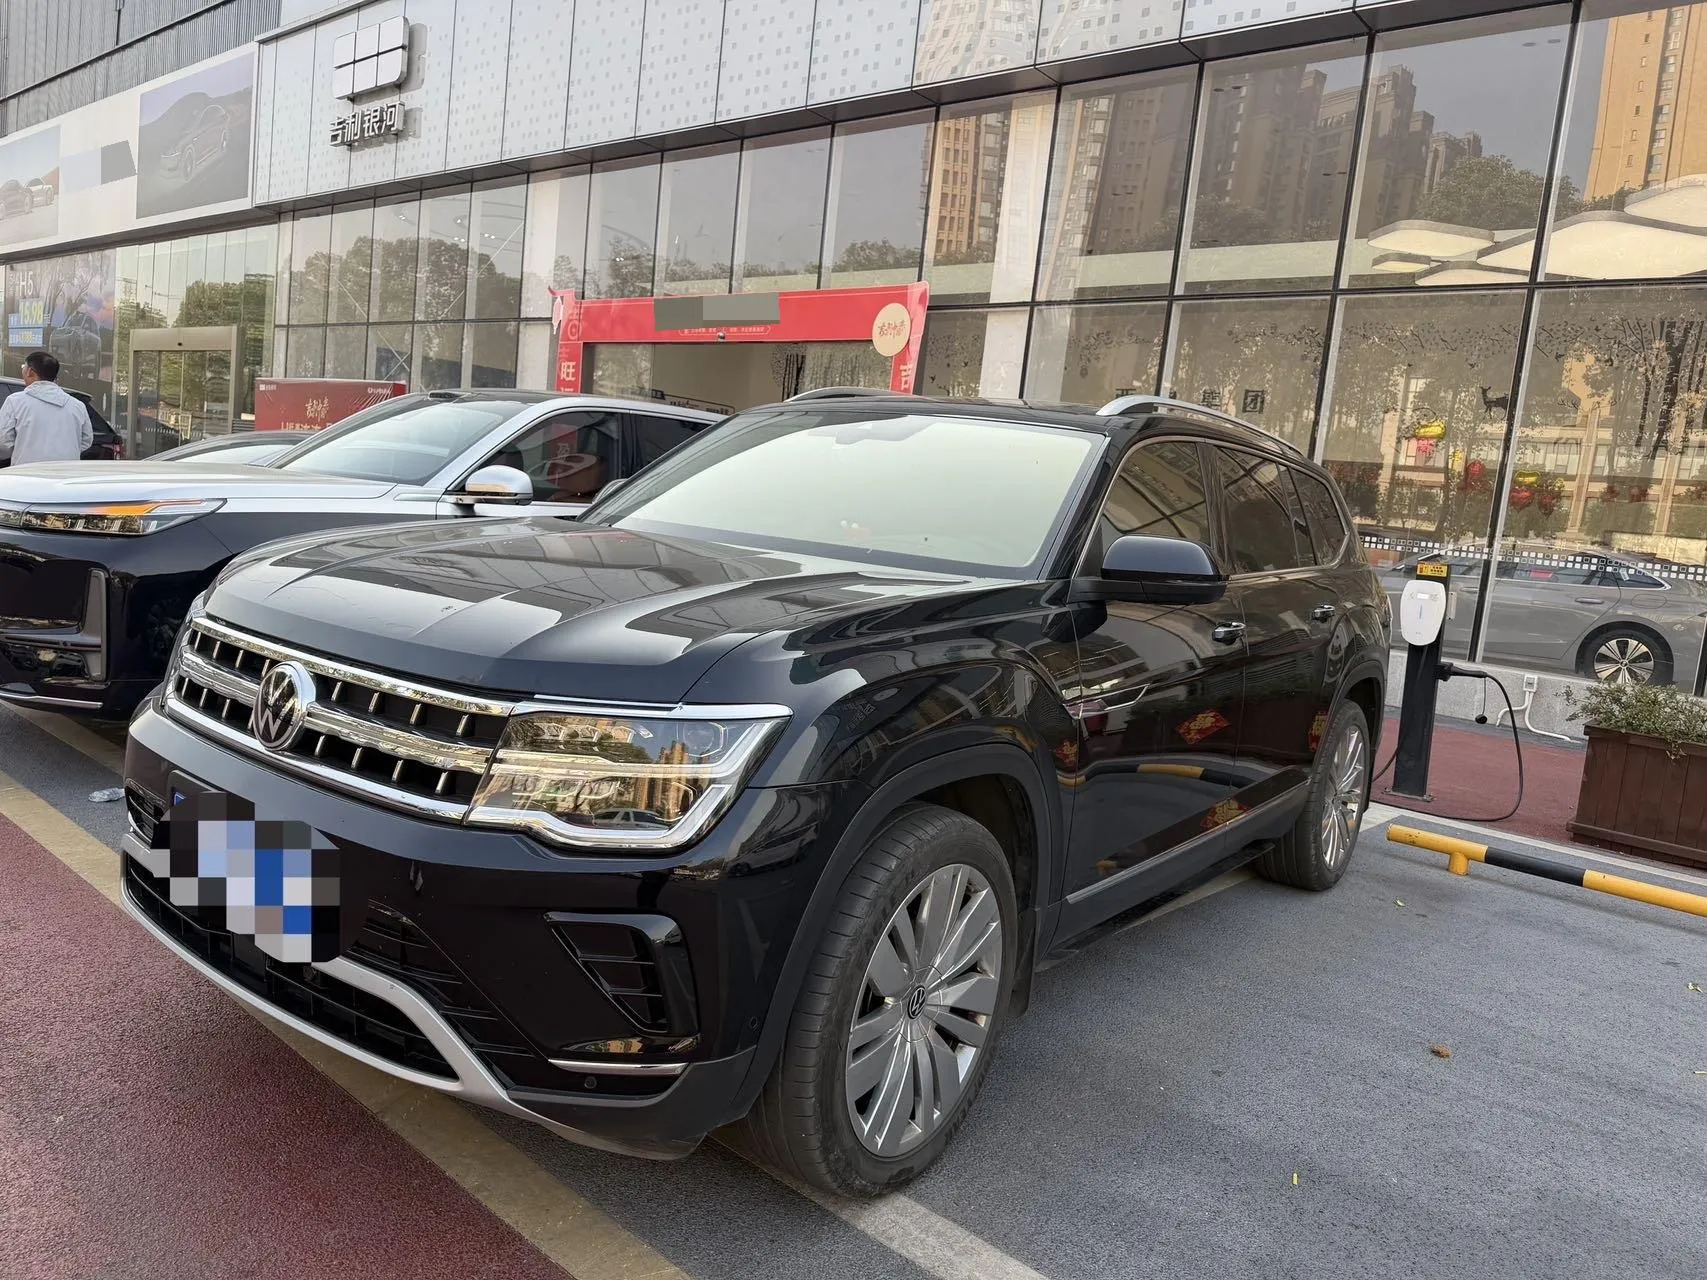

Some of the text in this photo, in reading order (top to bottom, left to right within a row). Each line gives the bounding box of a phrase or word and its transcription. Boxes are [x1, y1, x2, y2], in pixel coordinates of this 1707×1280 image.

[330, 102, 402, 145] 吉利银河
[20, 271, 34, 296] H5
